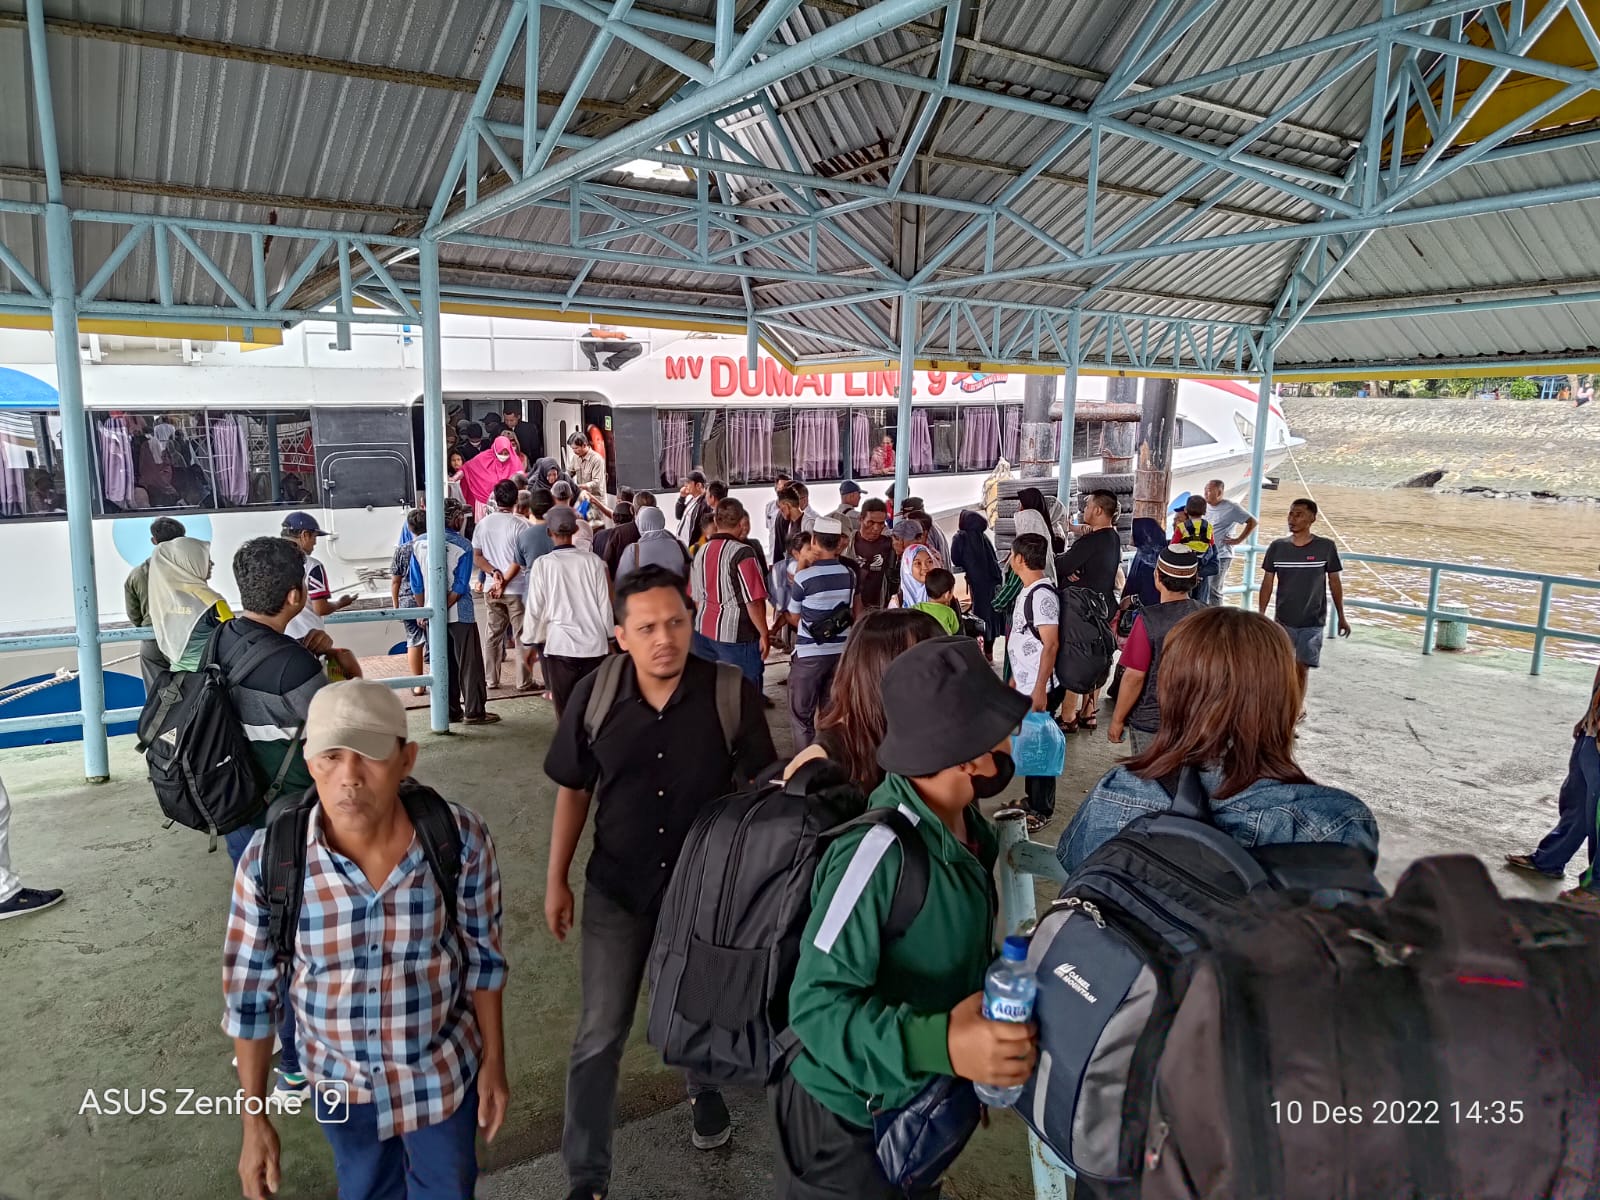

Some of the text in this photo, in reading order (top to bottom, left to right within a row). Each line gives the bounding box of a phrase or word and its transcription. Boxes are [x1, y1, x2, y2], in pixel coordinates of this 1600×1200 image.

[665, 356, 703, 379] MV
[928, 370, 947, 396] 9
[1062, 975, 1098, 1004] MOUNTAIN
[995, 1003, 1026, 1017] AQUA
